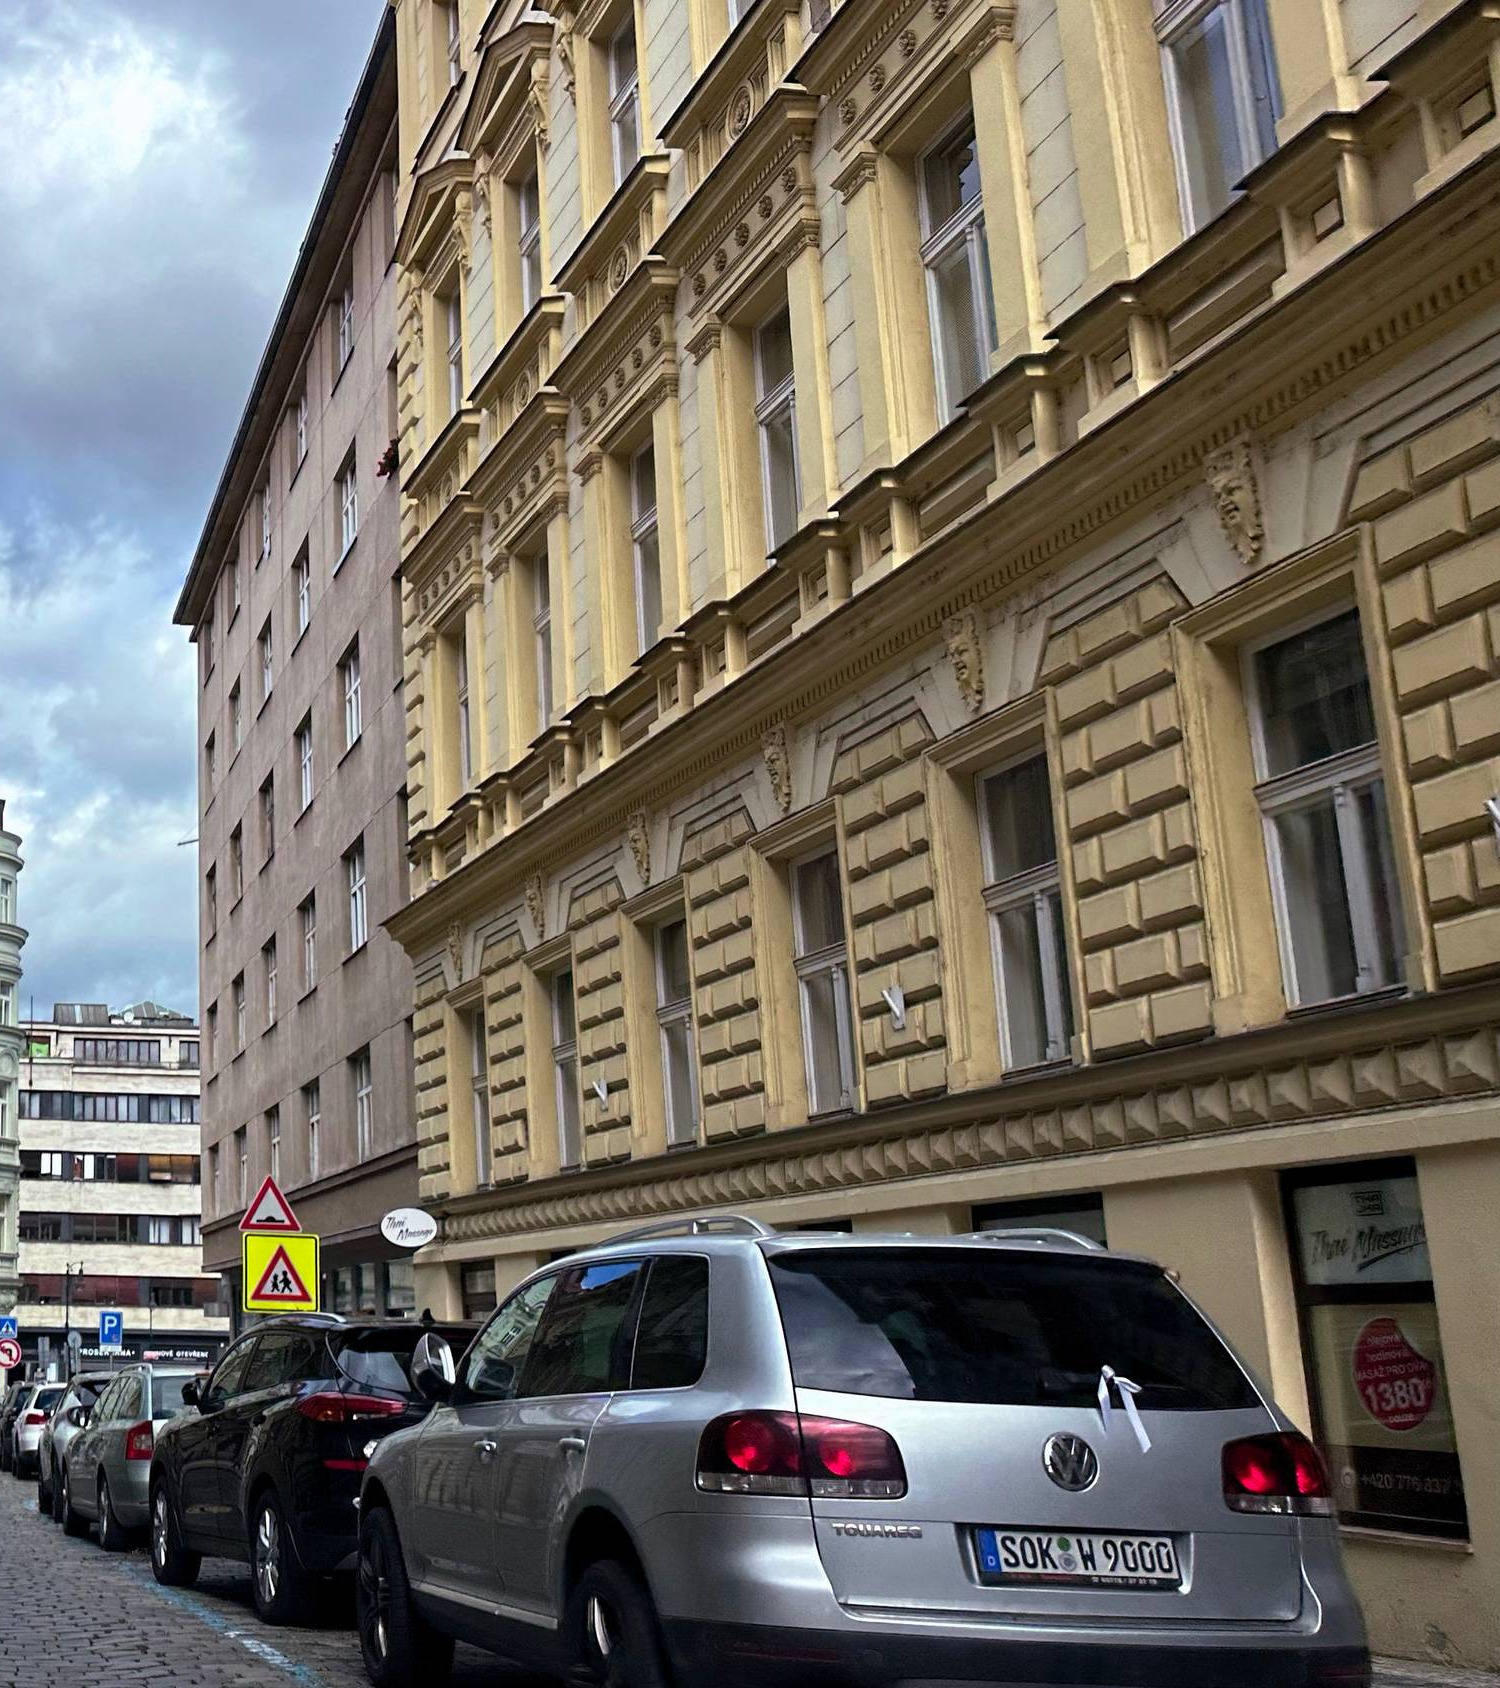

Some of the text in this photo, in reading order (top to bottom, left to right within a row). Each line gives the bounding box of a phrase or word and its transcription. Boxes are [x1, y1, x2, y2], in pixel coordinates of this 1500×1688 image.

[104, 1315, 117, 1335] P
[1365, 1378, 1425, 1412] 1380
[831, 1523, 923, 1539] TOUAREG
[1000, 1536, 1174, 1573] SOK W 9000
